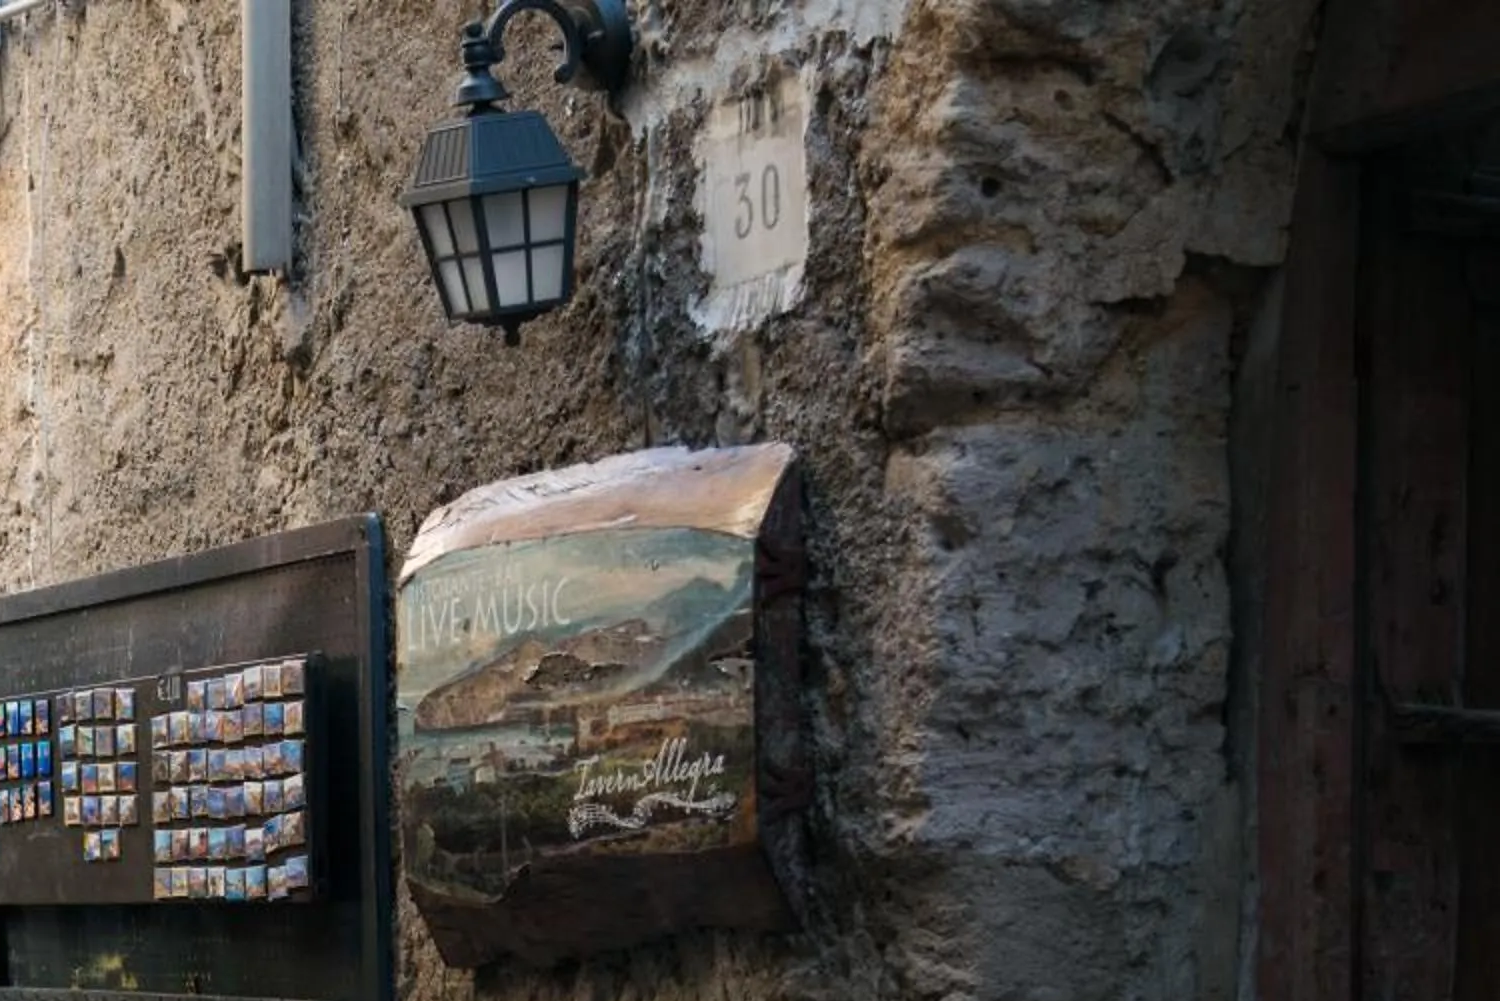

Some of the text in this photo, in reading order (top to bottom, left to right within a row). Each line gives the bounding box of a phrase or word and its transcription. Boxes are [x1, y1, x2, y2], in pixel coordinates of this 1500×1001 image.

[734, 163, 780, 240] 30
[407, 577, 571, 651] LIVE MUSIC
